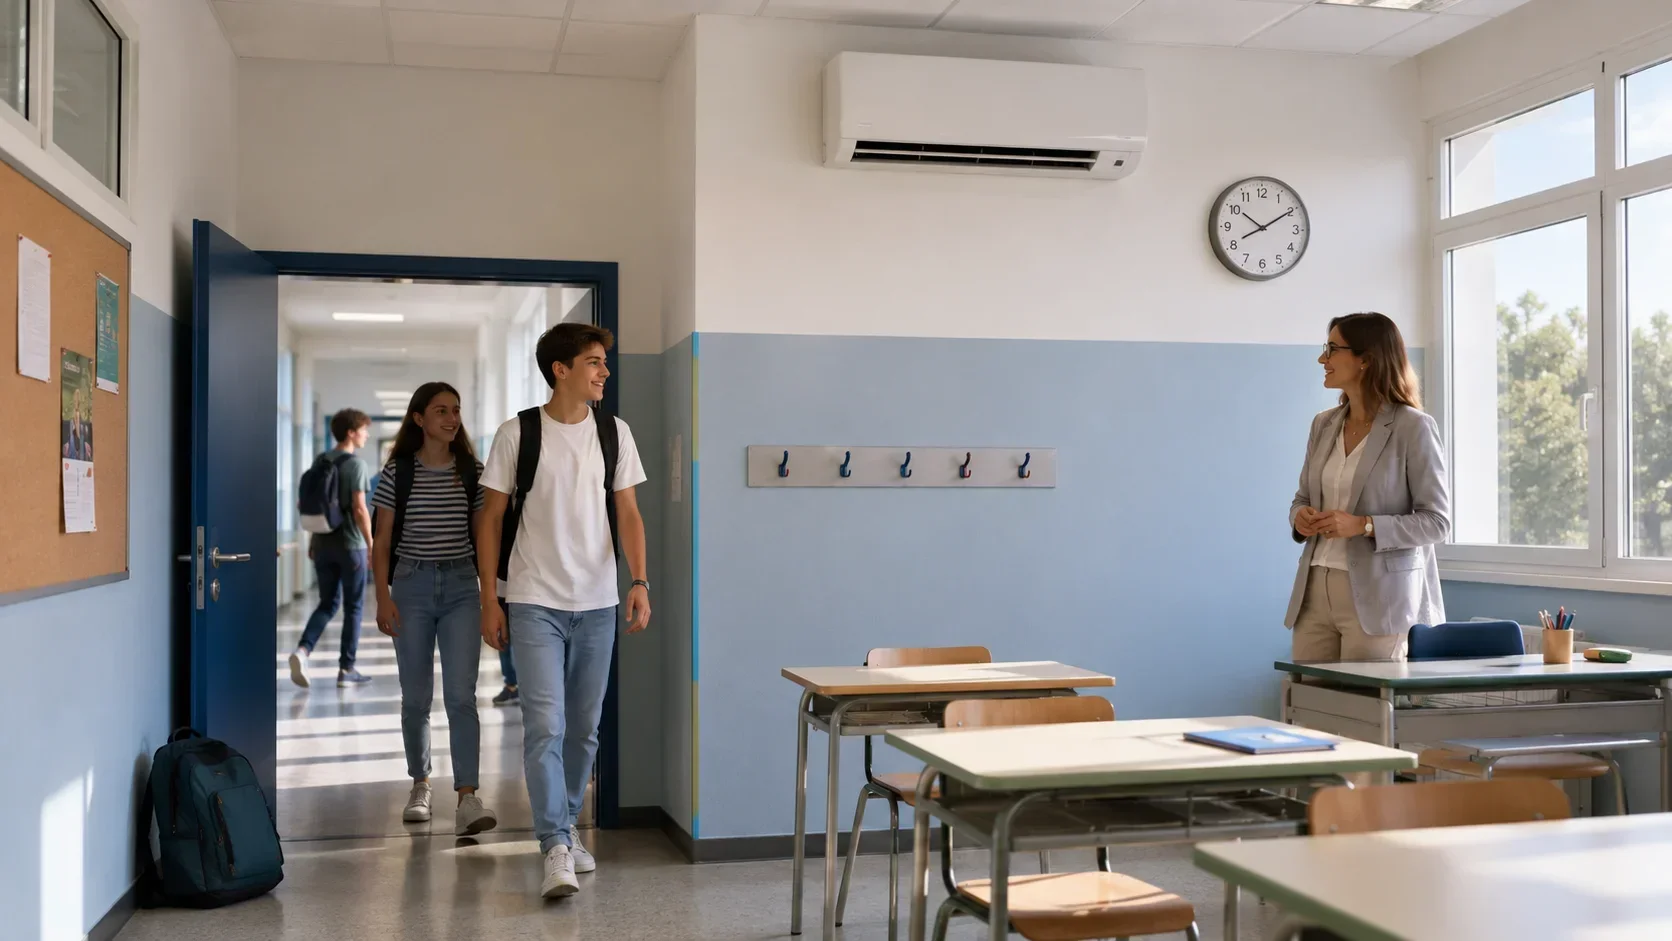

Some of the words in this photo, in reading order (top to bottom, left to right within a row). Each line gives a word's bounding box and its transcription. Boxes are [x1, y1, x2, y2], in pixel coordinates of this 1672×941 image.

[1241, 192, 1250, 202] 11
[1256, 188, 1268, 198] 12
[1229, 204, 1241, 215] 10
[1287, 206, 1294, 217] 2
[1224, 222, 1232, 232] 9
[1292, 224, 1300, 235] 3
[1230, 240, 1238, 250] 8
[1286, 242, 1294, 252] 4
[1242, 253, 1250, 263] 7
[1276, 254, 1282, 264] 5
[1258, 258, 1266, 269] 6
